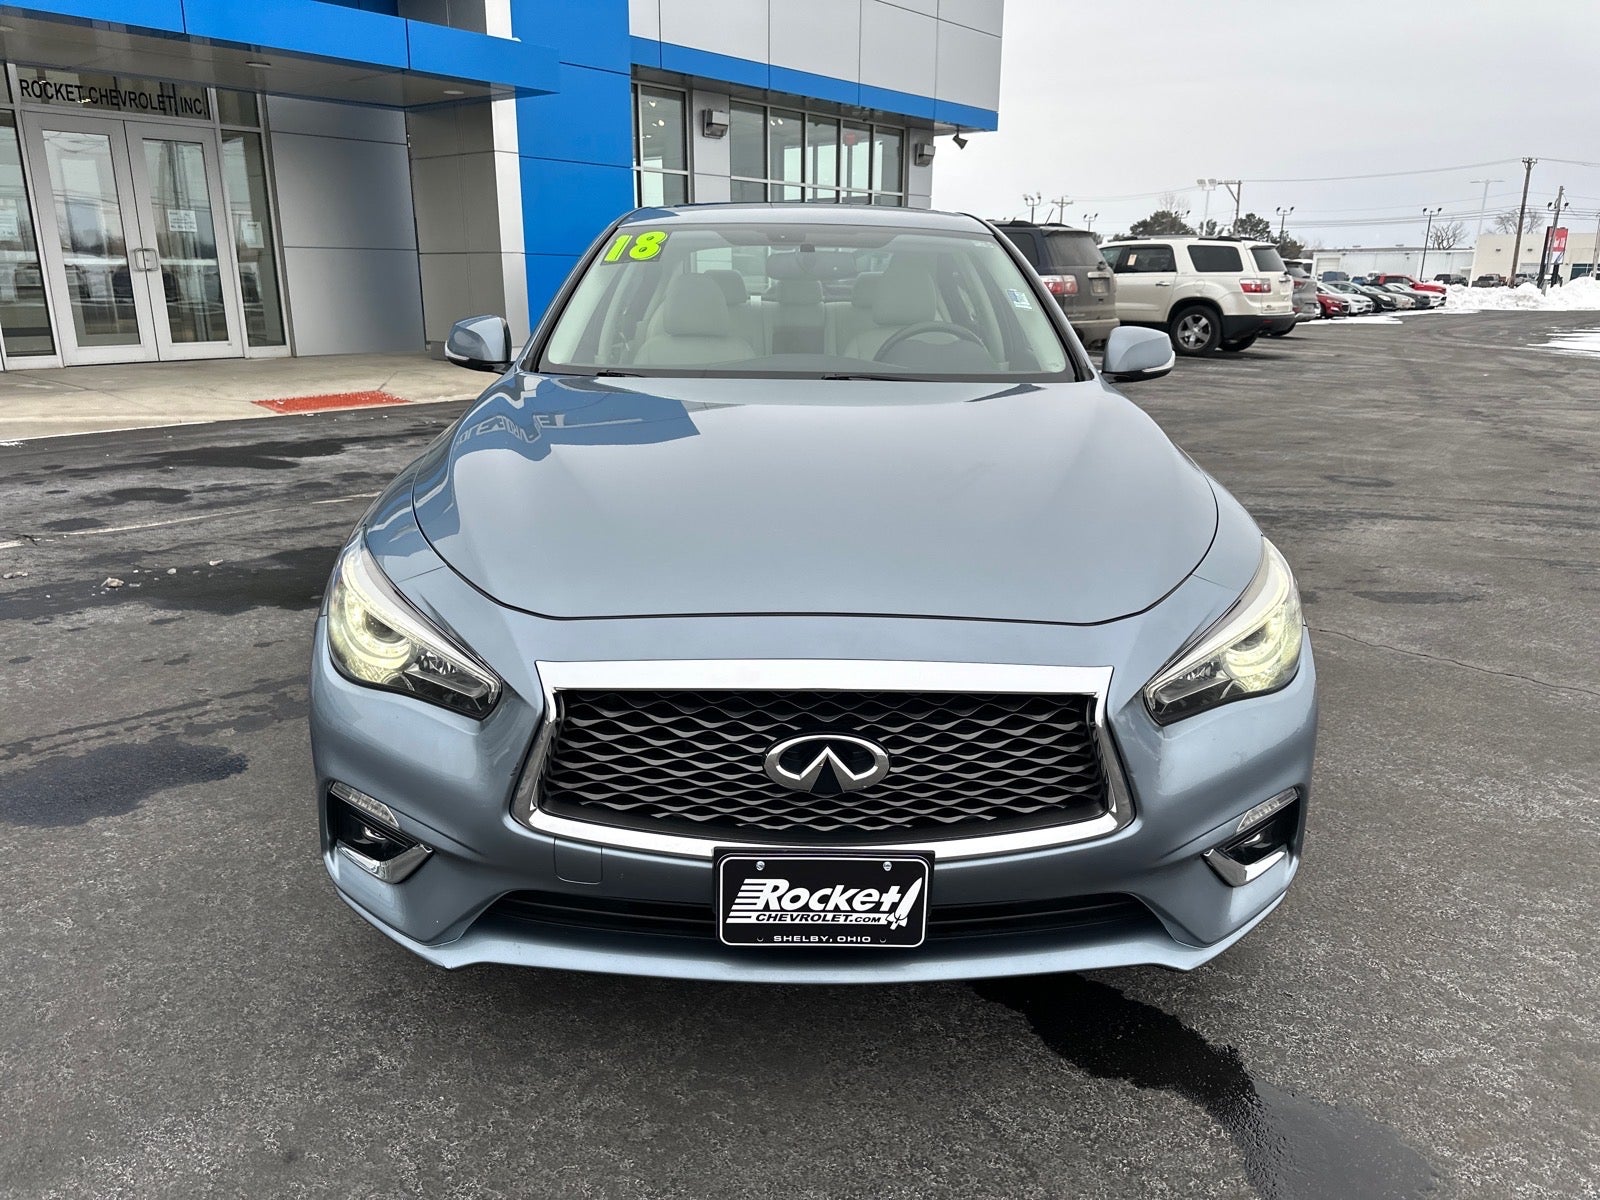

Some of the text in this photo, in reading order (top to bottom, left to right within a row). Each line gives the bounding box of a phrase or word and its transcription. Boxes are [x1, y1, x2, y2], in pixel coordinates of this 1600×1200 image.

[19, 78, 84, 102] ROCKET
[180, 96, 206, 116] INC.
[603, 231, 668, 262] 18
[730, 878, 902, 912] Rocket
[773, 935, 872, 943] SHELBY, OHIO
